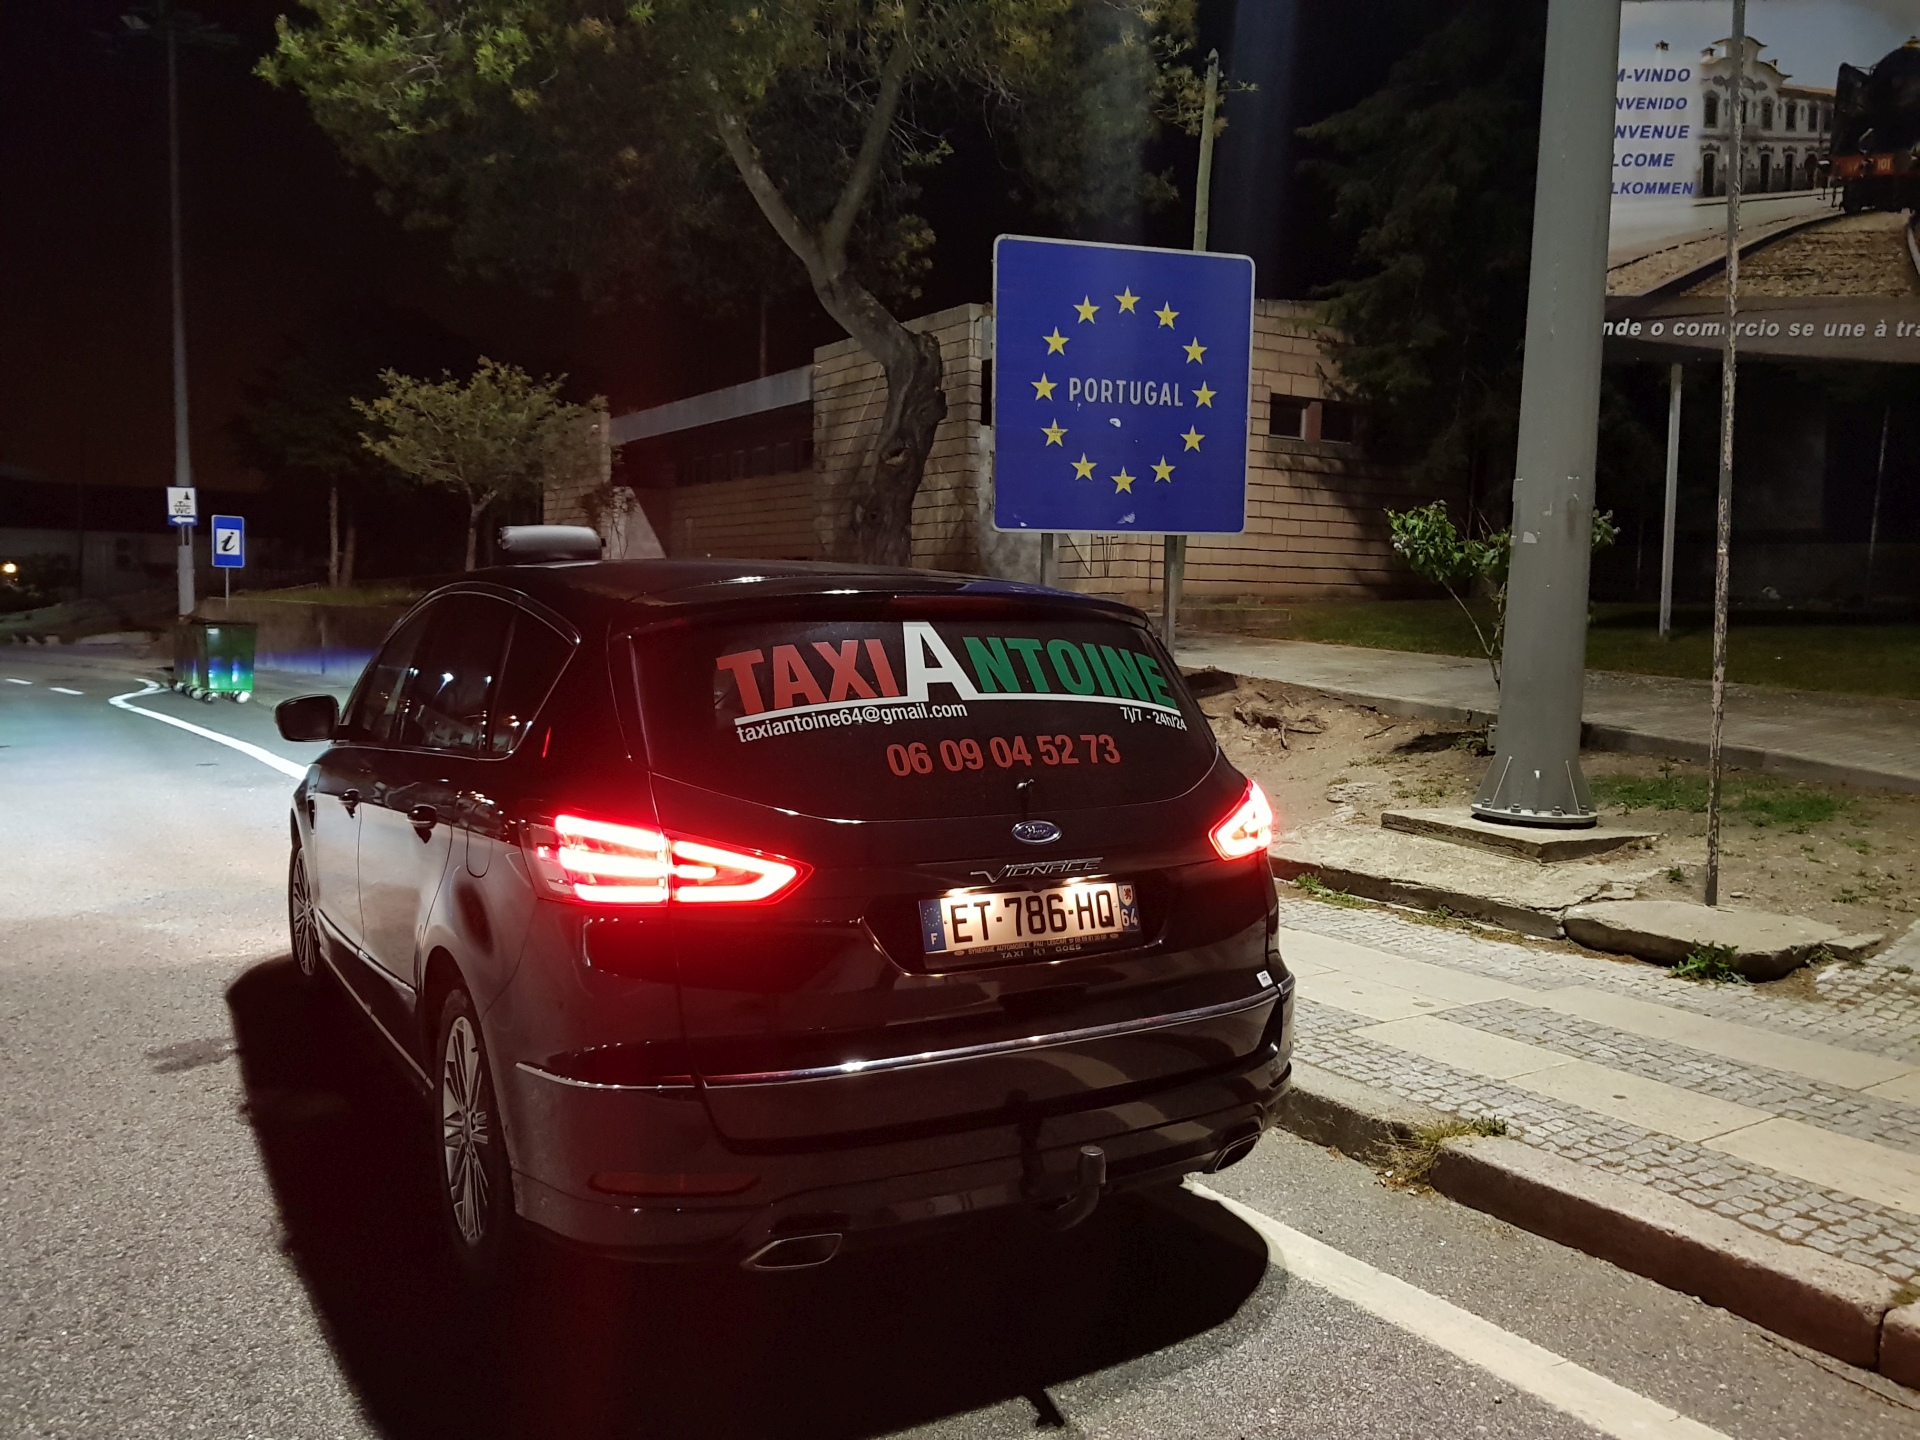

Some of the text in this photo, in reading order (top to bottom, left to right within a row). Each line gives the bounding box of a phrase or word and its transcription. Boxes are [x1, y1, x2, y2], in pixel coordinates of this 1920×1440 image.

[1614, 125, 1690, 139] NVENUE
[1611, 182, 1694, 195] LKOMMEN
[1602, 318, 1642, 336] nde
[1650, 322, 1665, 336] o
[1672, 319, 1781, 337] comrcio
[1788, 322, 1815, 337] se
[1823, 323, 1866, 337] une
[1874, 319, 1888, 337] à
[1068, 377, 1184, 407] PORTUGAL
[174, 507, 191, 515] WC
[715, 621, 1178, 717] TAXI ANTOINE
[736, 702, 968, 744] taxiantoine64@gmail.com
[1152, 711, 1188, 731] 24h/24
[886, 733, 1122, 777] 06 09 04 52 73
[950, 890, 1115, 944] ET-786-HQ
[1120, 907, 1139, 927] 64
[930, 932, 938, 945] F
[1001, 950, 1024, 959] TAXI
